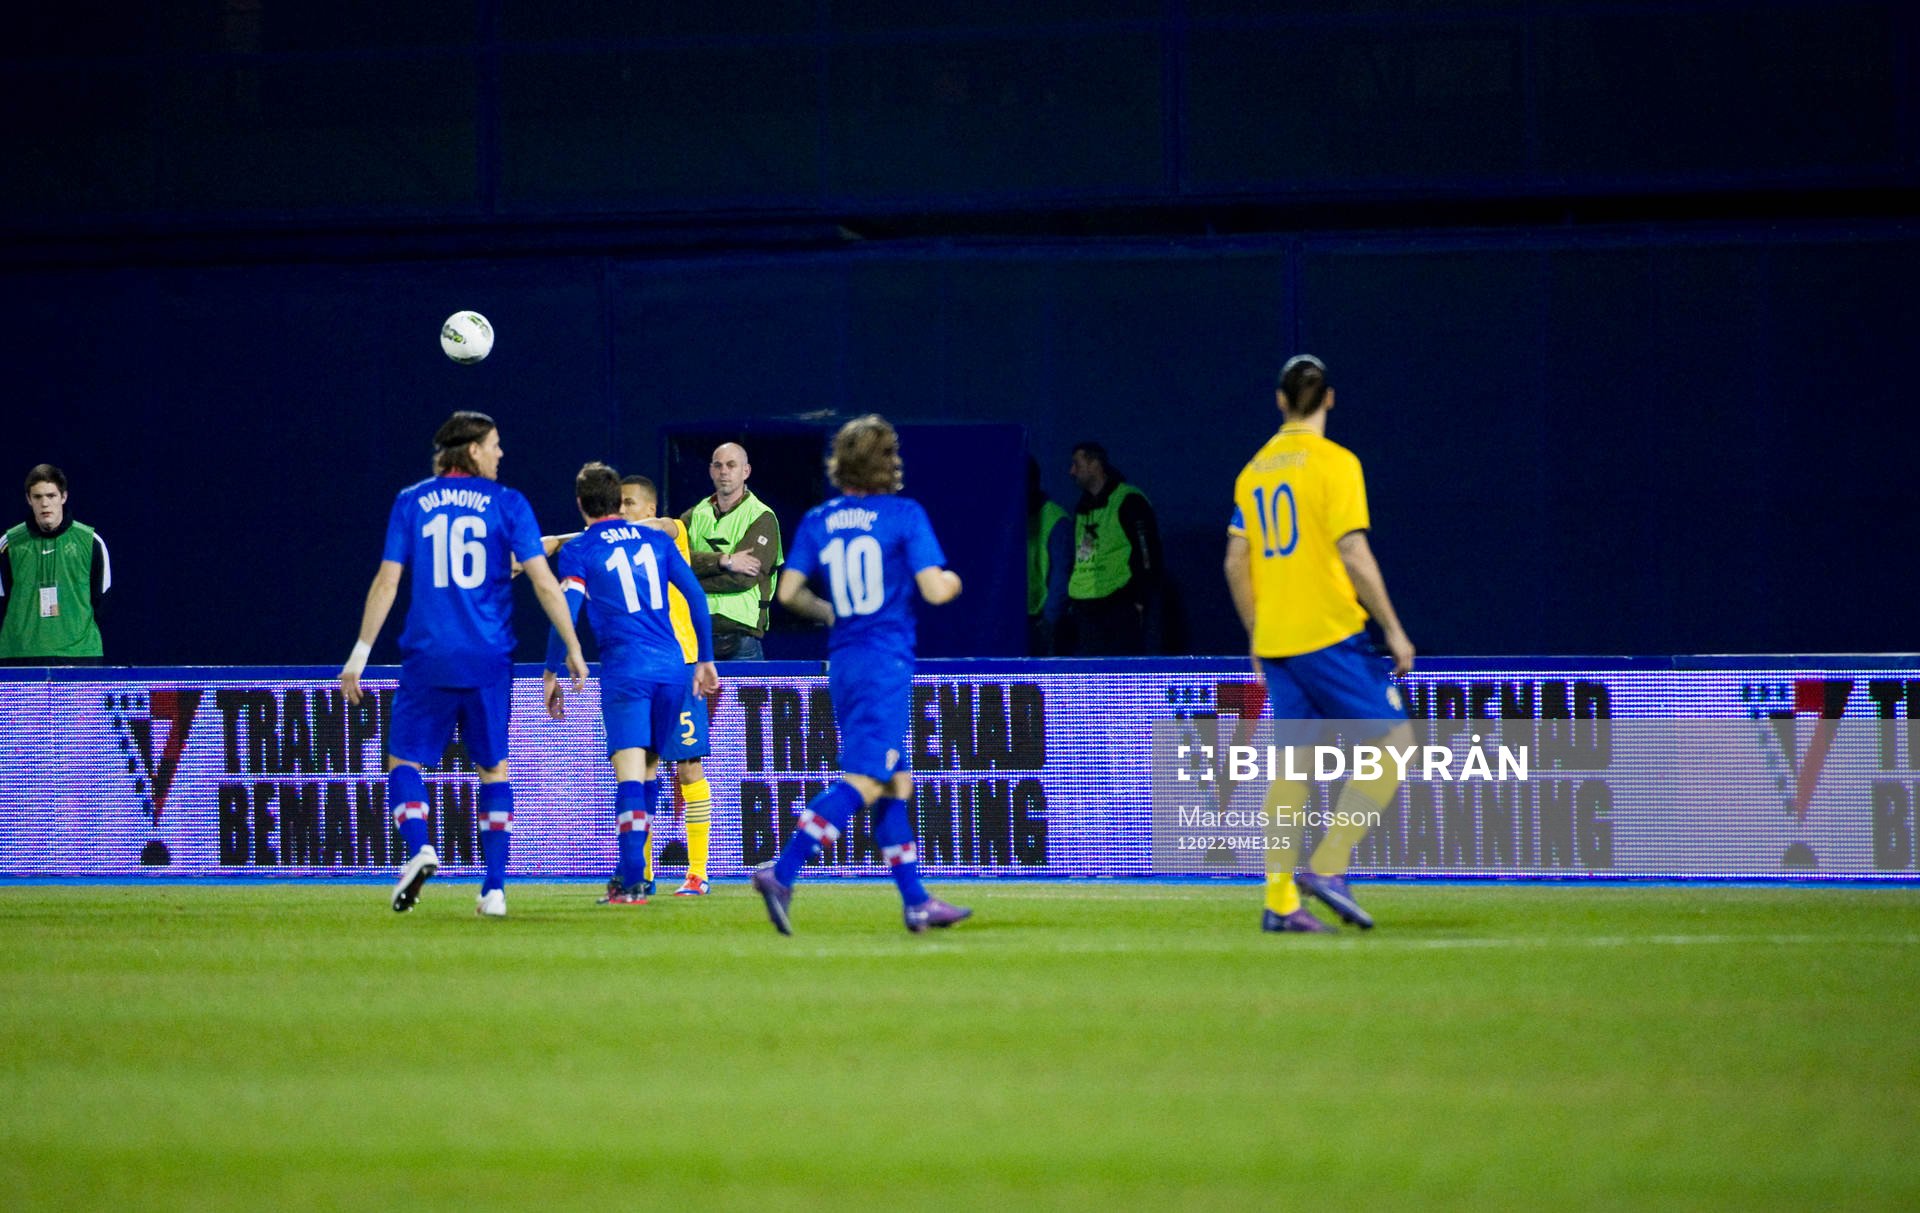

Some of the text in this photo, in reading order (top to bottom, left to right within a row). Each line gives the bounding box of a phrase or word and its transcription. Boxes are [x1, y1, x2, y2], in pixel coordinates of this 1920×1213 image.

[422, 513, 487, 589] 16
[600, 526, 642, 544] SRNA
[1253, 483, 1299, 558] 10
[604, 543, 664, 613] 11
[819, 534, 885, 618] 10
[680, 711, 695, 739] 5
[737, 685, 1046, 772] TRAENAD
